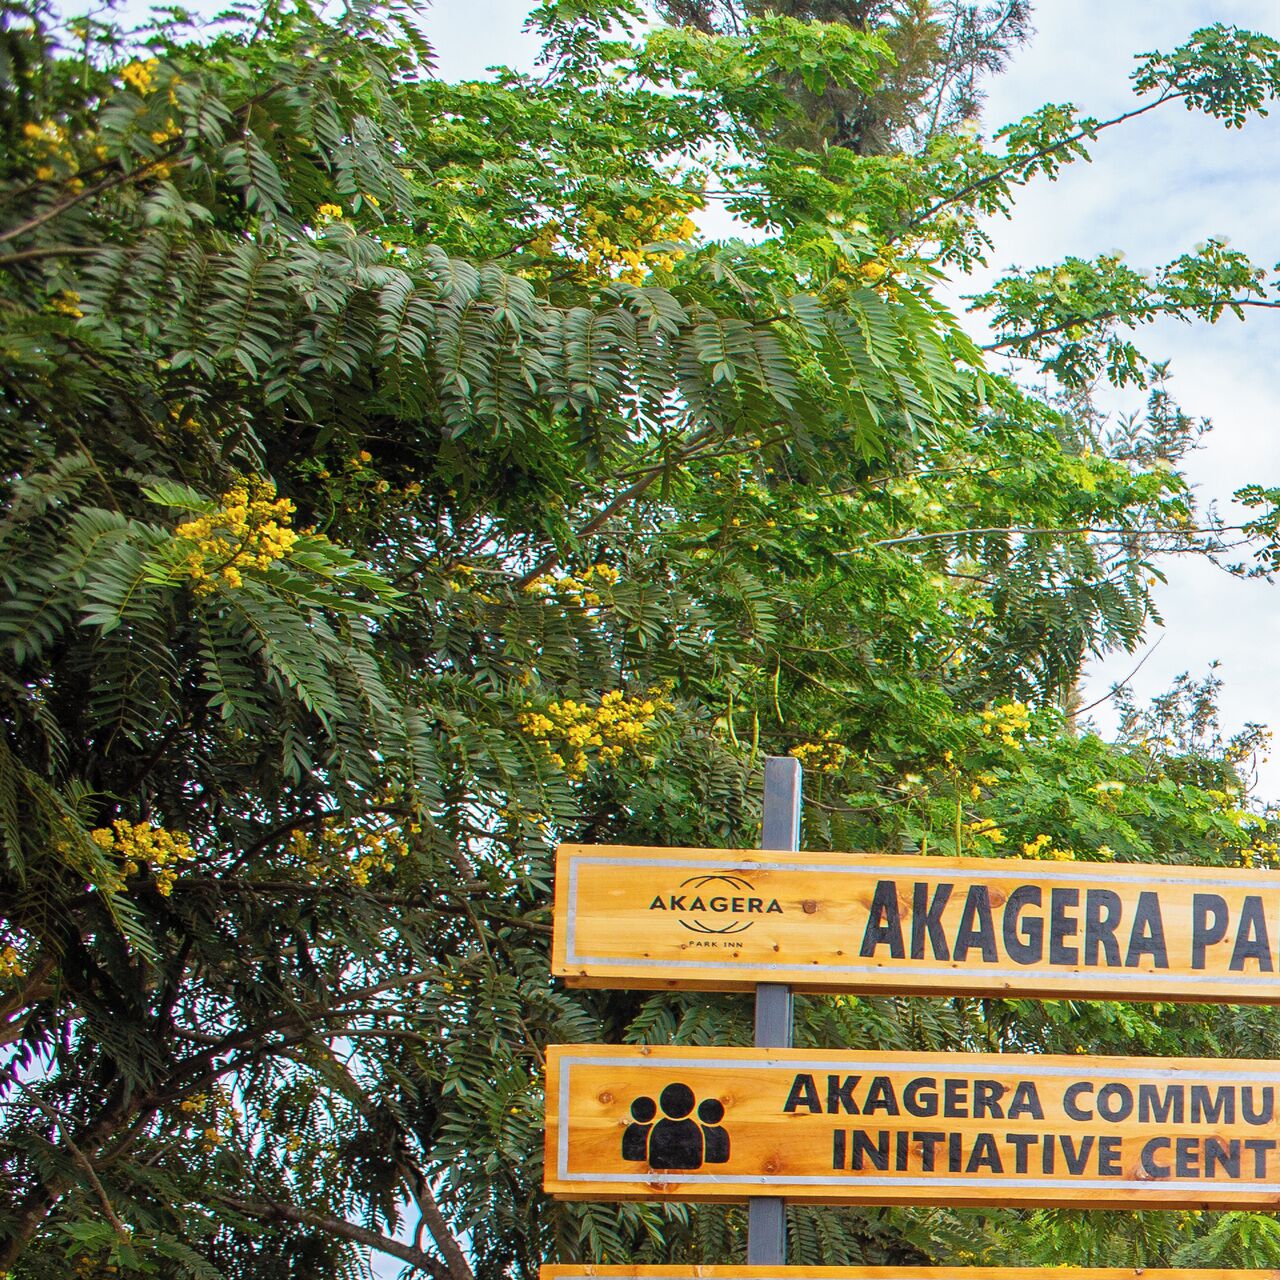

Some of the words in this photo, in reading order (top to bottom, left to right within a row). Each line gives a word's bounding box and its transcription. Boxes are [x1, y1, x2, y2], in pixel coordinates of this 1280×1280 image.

[649, 895, 784, 914] AKAGERA
[859, 880, 1168, 968] AKAGERA
[688, 940, 719, 948] PARK
[723, 941, 744, 949] INN
[783, 1074, 1044, 1120] AKAGERA
[833, 1129, 1122, 1176] INITIATIVE
